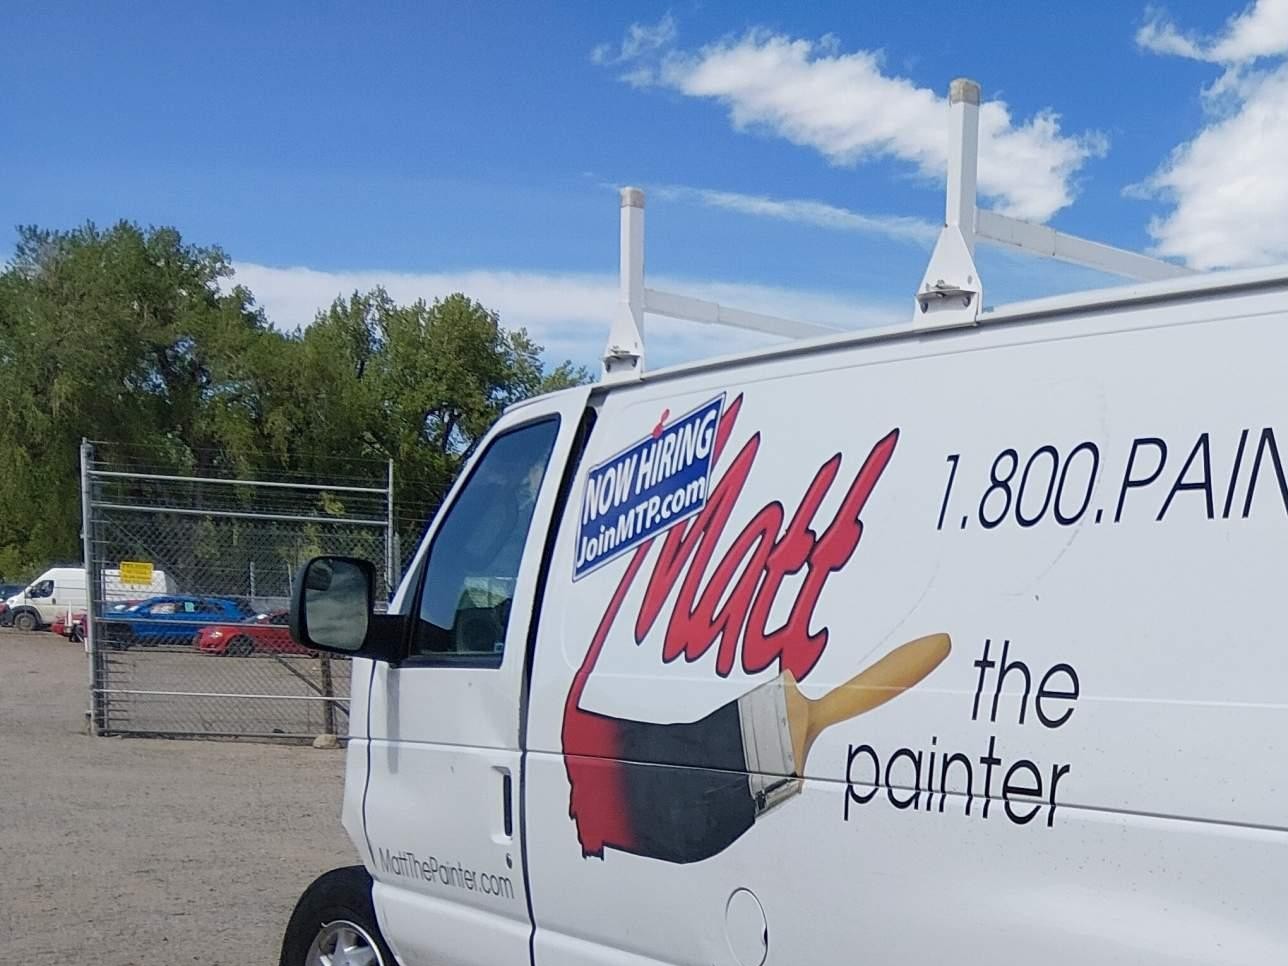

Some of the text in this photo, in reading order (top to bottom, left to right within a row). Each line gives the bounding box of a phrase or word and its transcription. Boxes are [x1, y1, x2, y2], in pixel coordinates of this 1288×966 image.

[583, 409, 717, 525] NOW HIRING
[577, 476, 706, 568] JoinMTP.com
[582, 393, 900, 683] Matt
[971, 639, 1080, 729] the
[843, 735, 1070, 828] painter
[378, 848, 515, 899] MattThePainter.com
